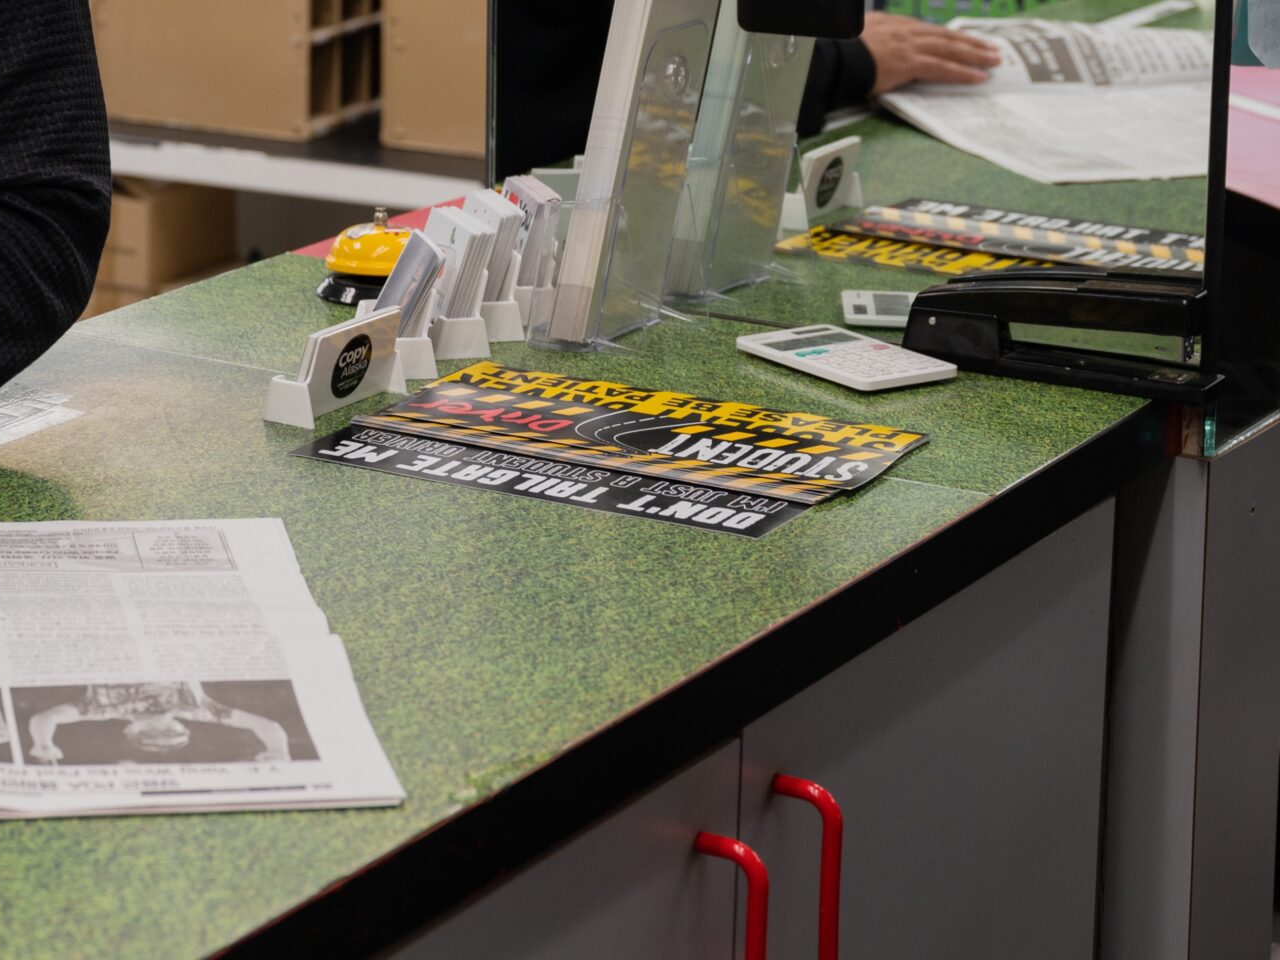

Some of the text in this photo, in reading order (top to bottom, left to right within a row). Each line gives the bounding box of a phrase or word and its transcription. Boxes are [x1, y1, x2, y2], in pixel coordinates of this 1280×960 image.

[338, 342, 370, 368] Copy
[341, 358, 368, 379] Alaska
[410, 397, 869, 482] STUDENT Driver
[478, 368, 900, 440] PLEASE BE PATIENT
[317, 439, 767, 531] DON'T TAILGATE ME
[351, 430, 787, 514] I'M JUST A STUDENT DRIVER
